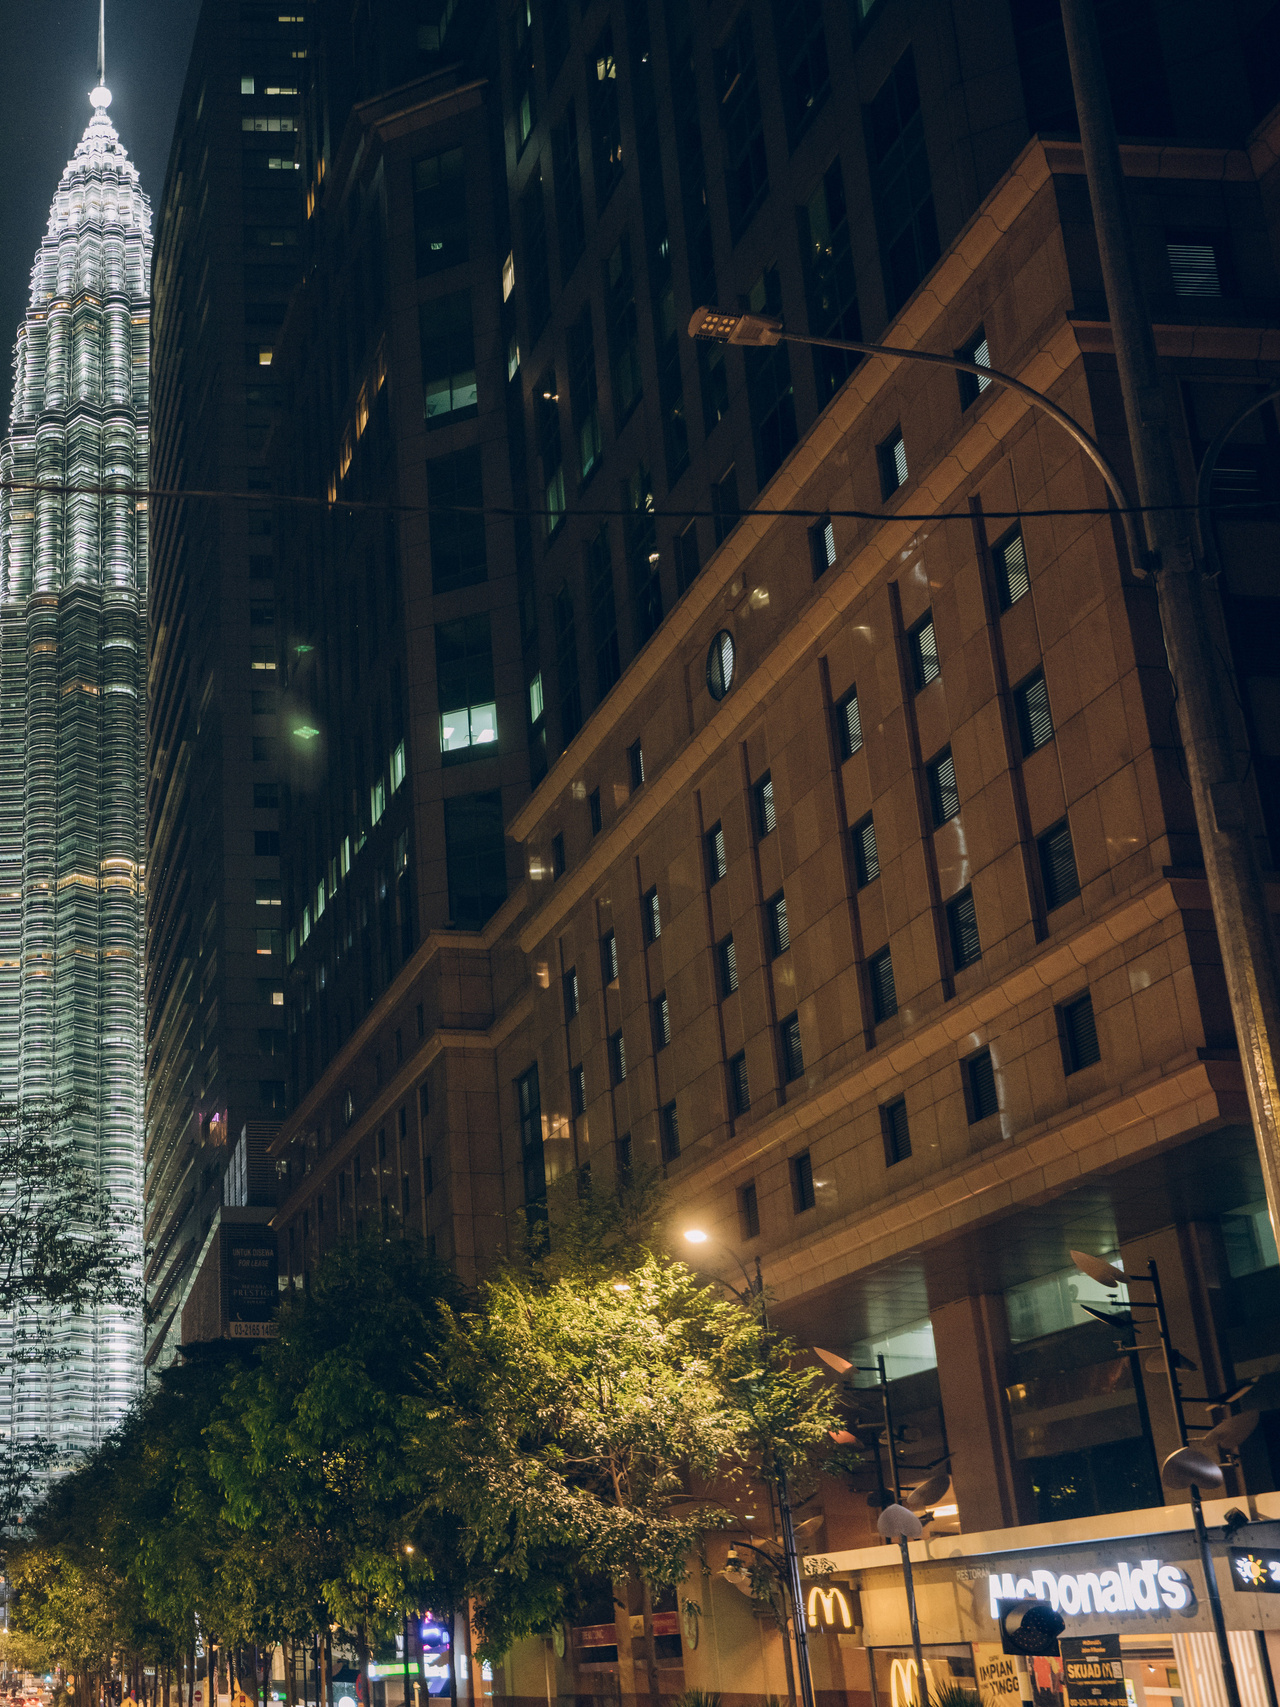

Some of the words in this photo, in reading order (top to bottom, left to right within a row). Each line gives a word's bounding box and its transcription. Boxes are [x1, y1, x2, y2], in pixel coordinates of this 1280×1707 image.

[232, 1248, 252, 1257] UNTUK
[252, 1248, 274, 1257] DISEWA
[238, 1259, 250, 1267] FOR
[251, 1259, 269, 1267] LEASE
[955, 1567, 991, 1581] RESTORAN
[988, 1559, 1188, 1619] McDonald's
[979, 1660, 1013, 1682] IMPIAN
[1066, 1663, 1102, 1679] SKUAD
[989, 1676, 1020, 1696] TINGG
